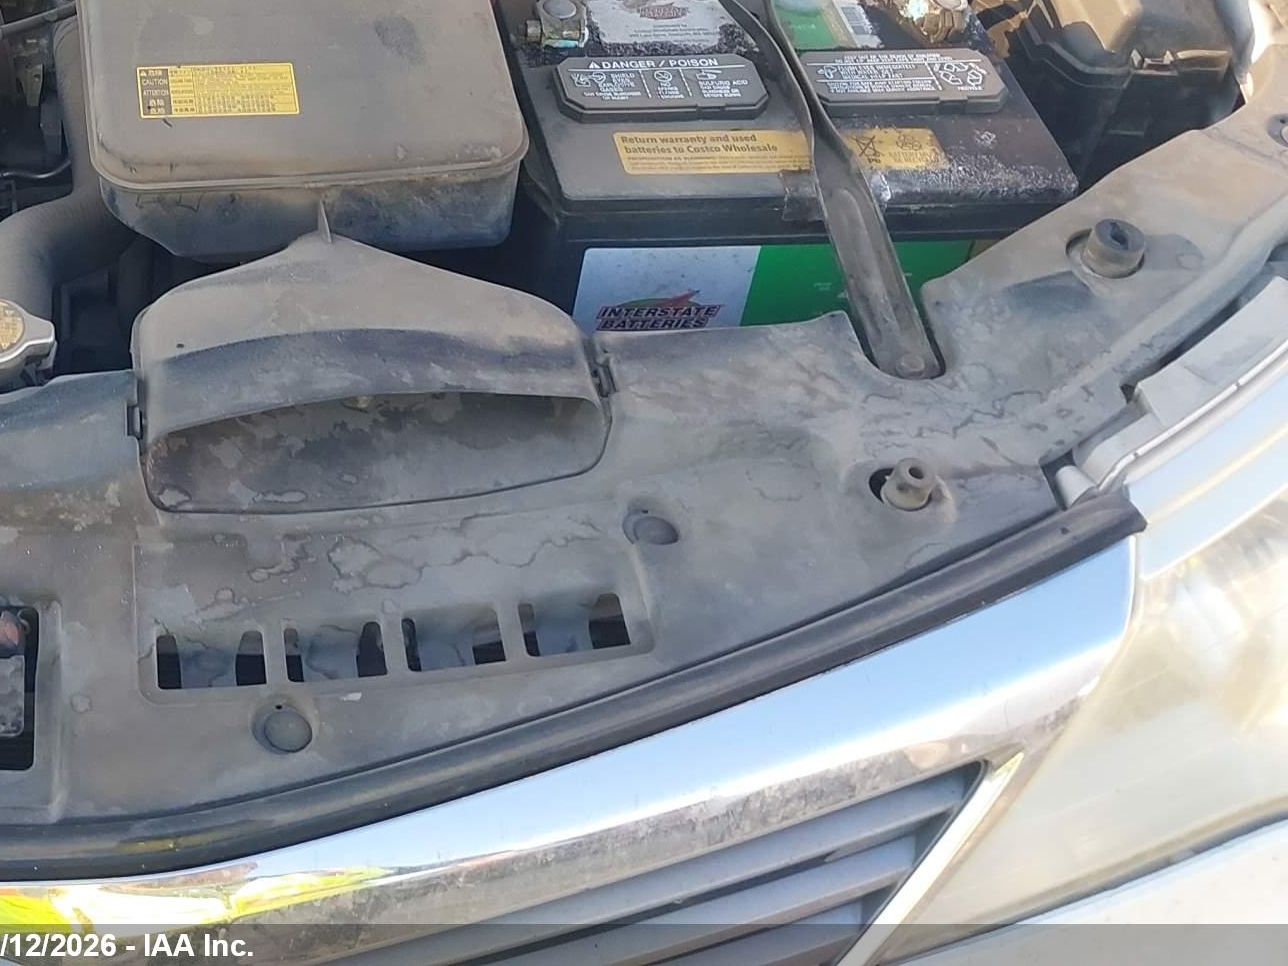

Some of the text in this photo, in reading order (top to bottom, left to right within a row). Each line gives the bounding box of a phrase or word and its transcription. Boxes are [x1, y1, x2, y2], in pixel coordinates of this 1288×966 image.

[601, 59, 657, 69] DANGER
[668, 58, 719, 67] POISON
[620, 134, 757, 145] Return warranty and used
[624, 143, 778, 154] batteries to Costco Wholesale
[599, 305, 719, 318] INTERSTATE
[599, 318, 706, 330] BATTERIES
